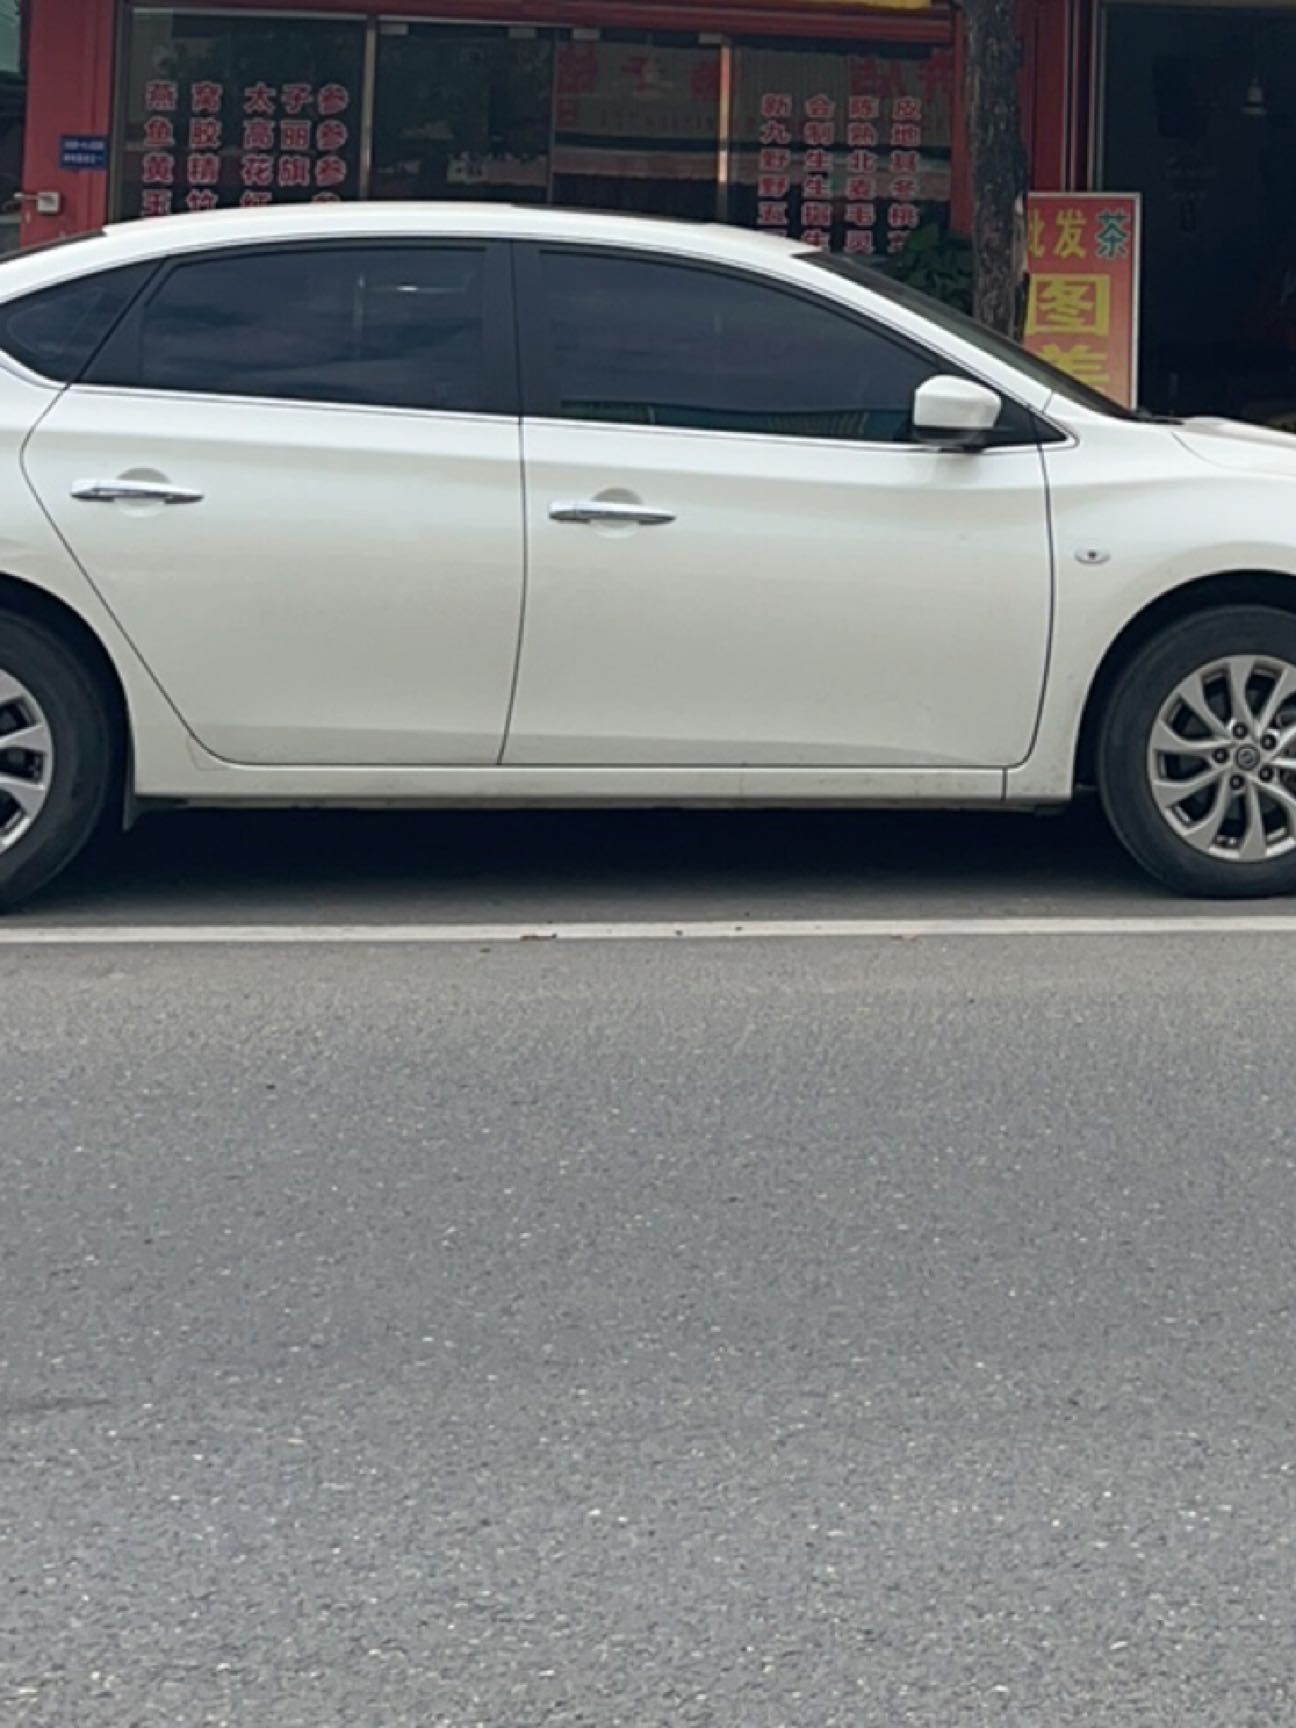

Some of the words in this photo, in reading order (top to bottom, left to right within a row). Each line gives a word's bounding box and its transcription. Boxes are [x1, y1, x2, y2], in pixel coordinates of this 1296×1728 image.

[243, 80, 349, 115] 太子参
[143, 115, 222, 149] 鱼胶
[242, 117, 348, 151] 高丽参
[240, 153, 347, 187] 花旗参
